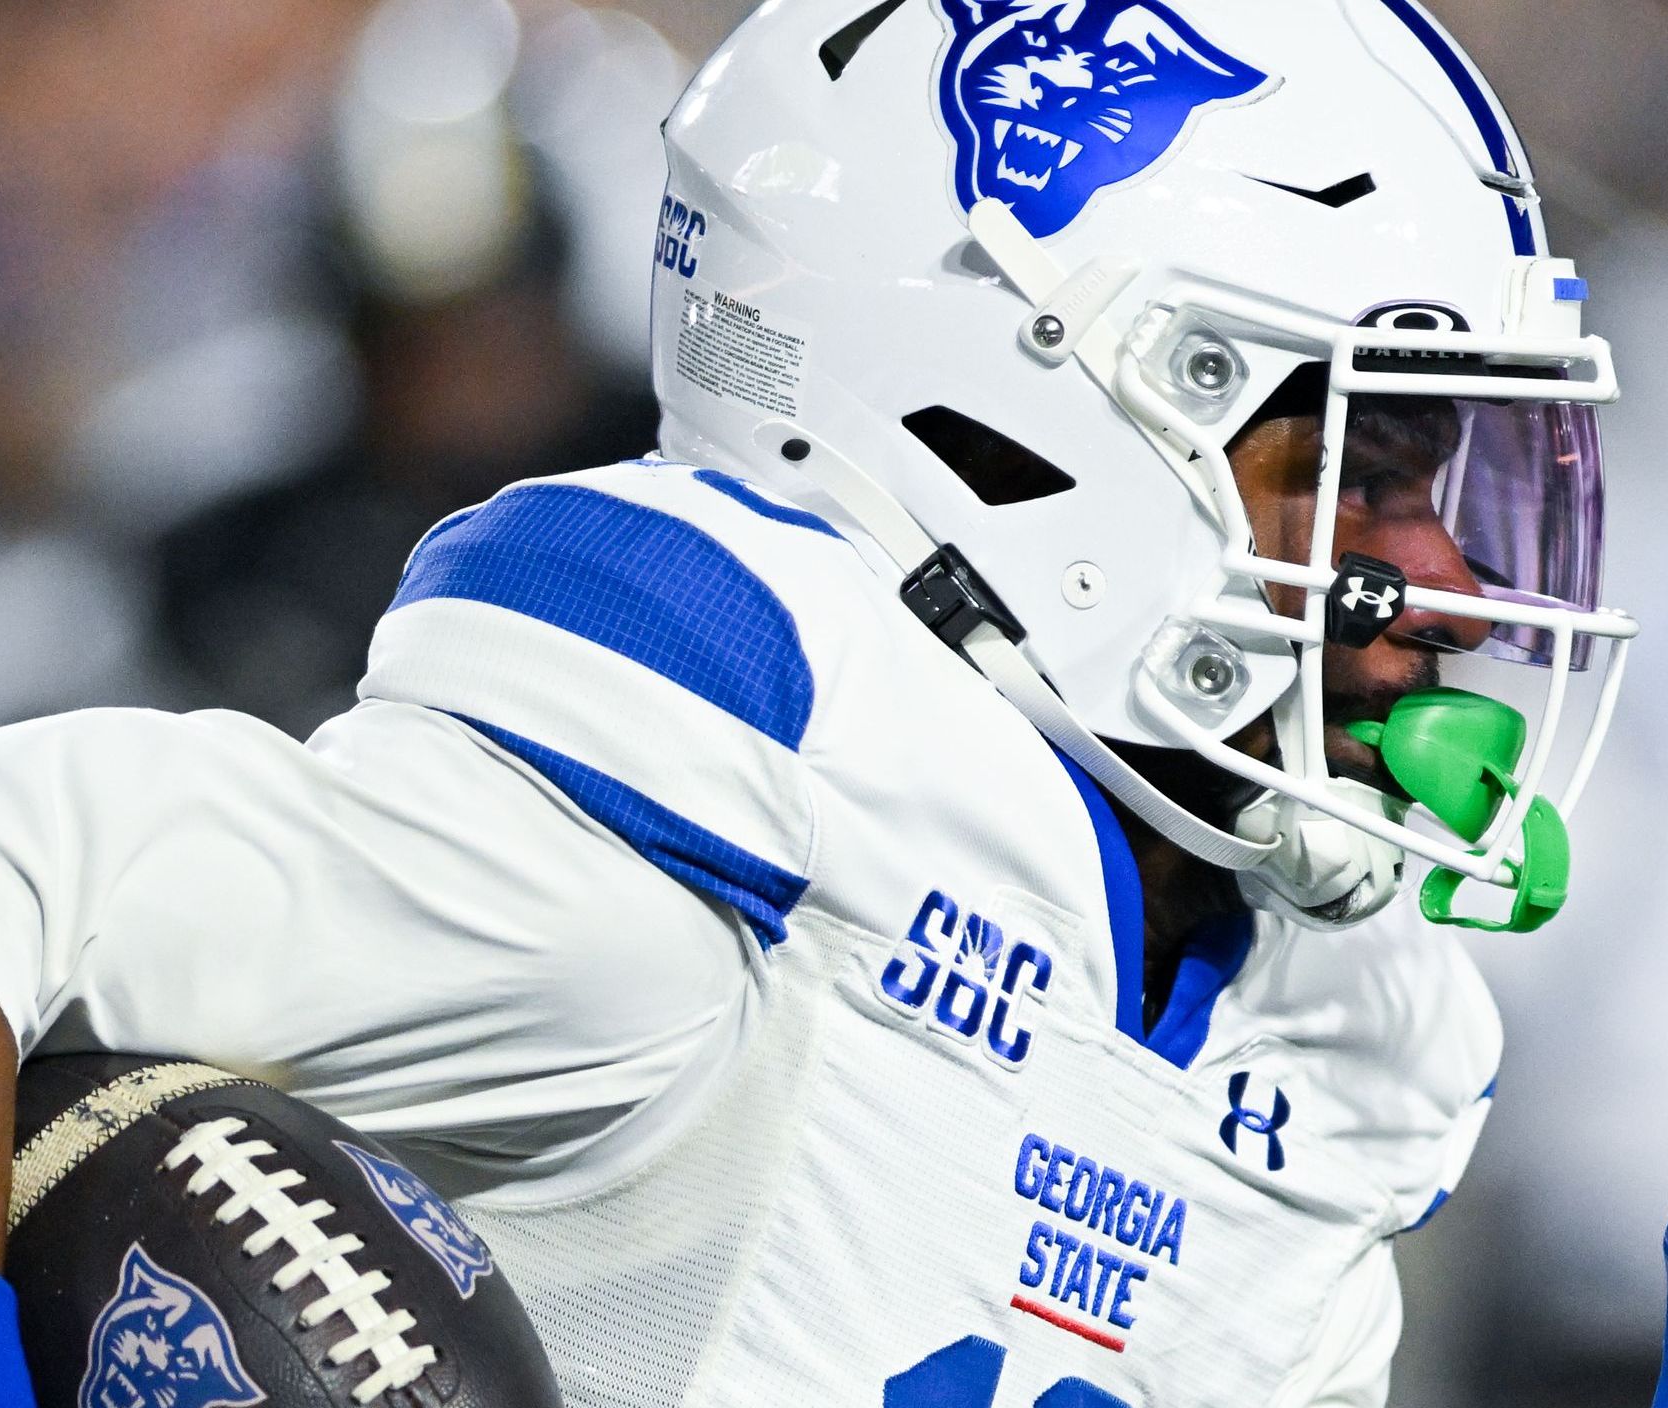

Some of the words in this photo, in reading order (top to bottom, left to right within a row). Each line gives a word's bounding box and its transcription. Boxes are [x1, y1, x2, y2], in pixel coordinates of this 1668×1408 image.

[714, 290, 761, 322] WARNING
[880, 889, 1053, 1064] SBC
[1014, 1132, 1188, 1266] GEORGIA
[1019, 1220, 1149, 1330] STATE
